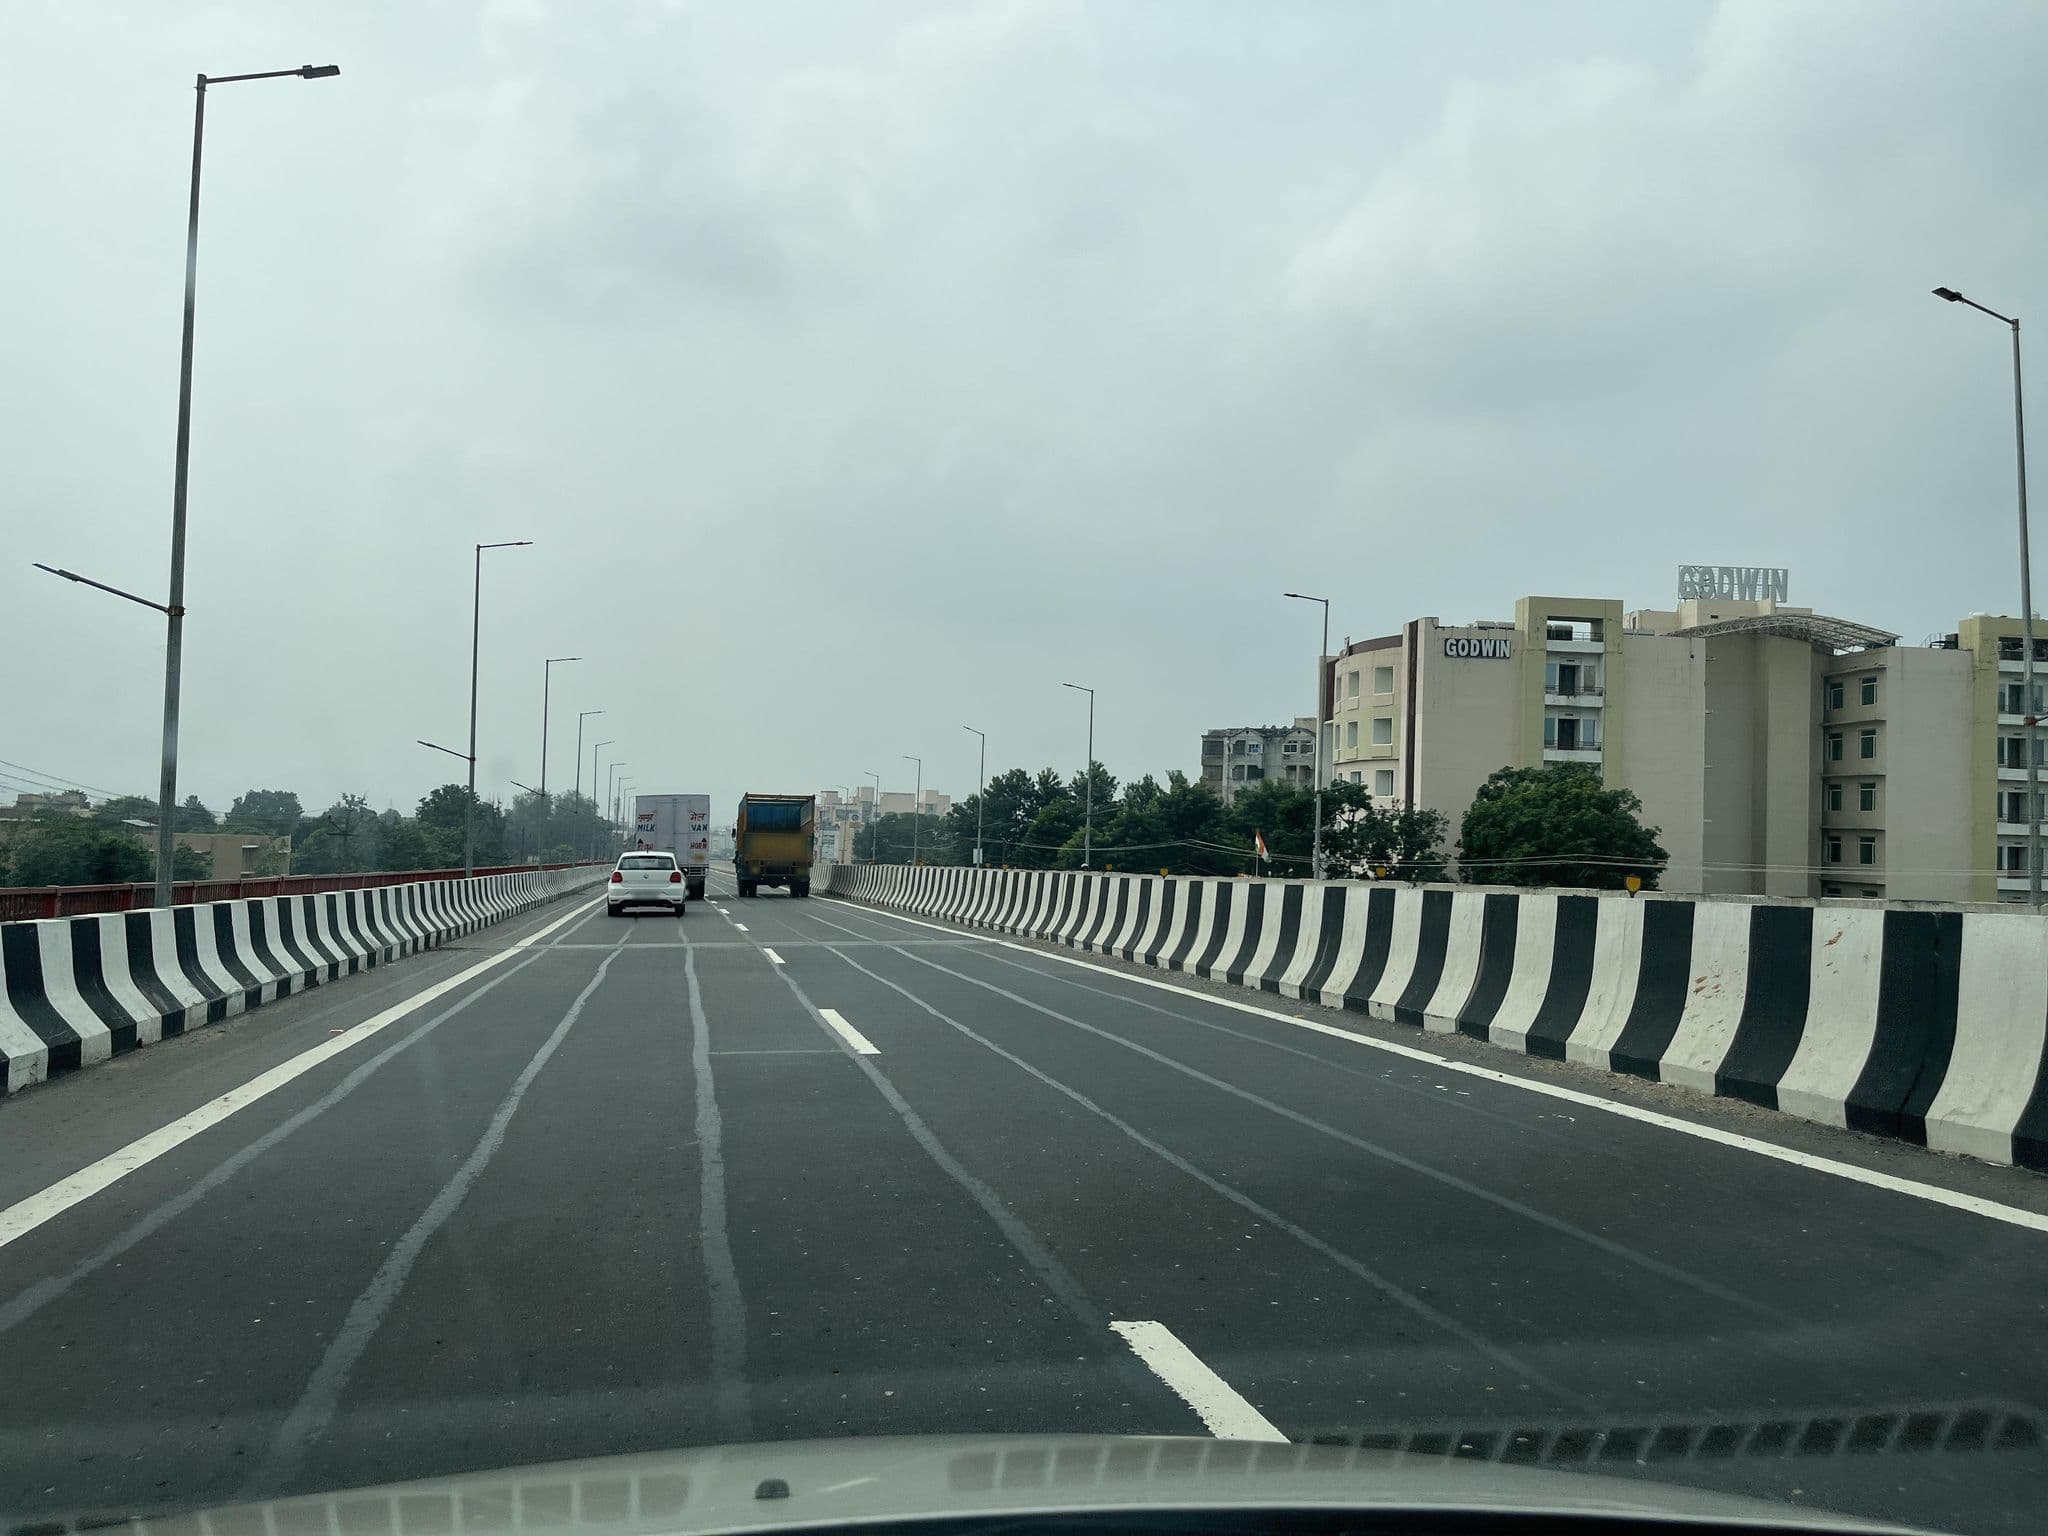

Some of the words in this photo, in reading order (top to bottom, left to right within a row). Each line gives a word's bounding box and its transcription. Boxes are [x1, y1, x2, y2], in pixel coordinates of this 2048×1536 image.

[1679, 565, 1787, 602] GODWIN
[1445, 638, 1511, 658] GODWIN
[637, 824, 655, 832] MILK
[691, 823, 708, 832] VAN
